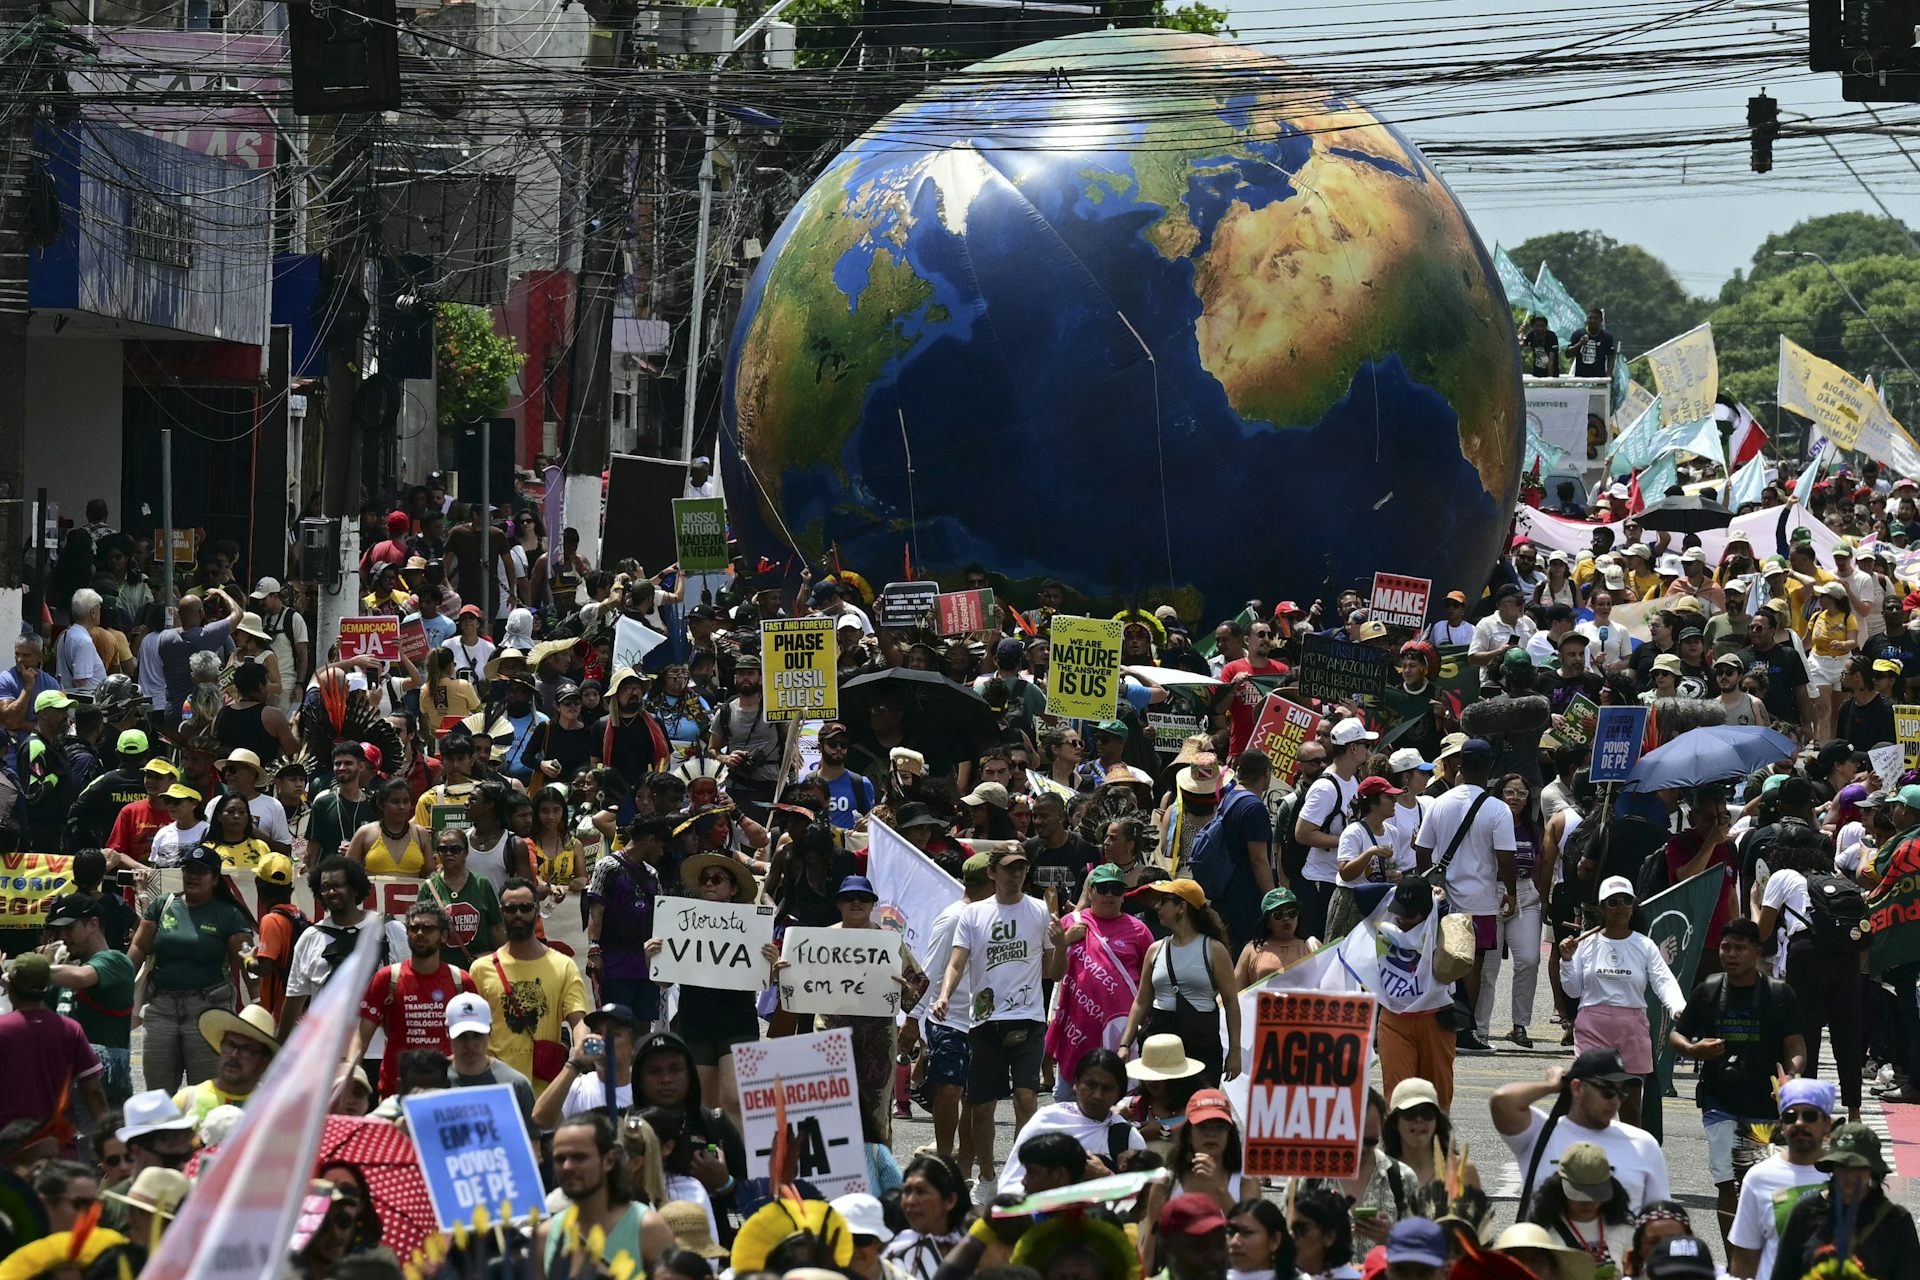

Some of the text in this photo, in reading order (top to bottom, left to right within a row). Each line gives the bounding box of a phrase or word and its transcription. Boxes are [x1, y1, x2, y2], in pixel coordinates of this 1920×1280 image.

[682, 512, 717, 524] NOSSO
[681, 523, 720, 535] FUTURO
[690, 546, 724, 558] VENDA
[1374, 587, 1426, 615] MAKE
[764, 619, 833, 631] FAST AND FOREVER
[1372, 610, 1422, 628] POLLUTERS
[774, 633, 824, 652] PHASE
[1070, 638, 1103, 648] WE ARE
[784, 652, 815, 669] OUT
[1053, 643, 1118, 669] NATURE
[1057, 663, 1112, 676] THE ANSWER
[1327, 657, 1382, 678] AMAZONIA
[774, 670, 827, 690] FOSSIL
[1058, 672, 1107, 698] IS US
[1300, 684, 1309, 694] IS
[1304, 667, 1382, 693] OUR LIBERATION
[778, 688, 824, 708] FUELS
[768, 711, 785, 721] FAST
[803, 708, 835, 719] OREVER
[1149, 714, 1162, 722] COP
[1285, 706, 1312, 729] END
[1281, 720, 1307, 744] THE
[1603, 741, 1630, 754] POVOS
[1601, 755, 1614, 770] DE
[454, 914, 478, 925] VENDA
[678, 906, 747, 934] Floresta
[991, 919, 1017, 942] EU
[667, 938, 752, 968] VIVA
[793, 938, 891, 965] FLORESTA
[803, 972, 866, 995] EM PÉ
[404, 1003, 444, 1011] TRANSIÇÃO
[1256, 1031, 1361, 1087] AGRO
[433, 1104, 493, 1123] FLORESTA
[1249, 1084, 1357, 1141] MATA
[438, 1123, 472, 1151] EM
[445, 1147, 510, 1179] POVOS
[453, 1175, 486, 1208] DE
